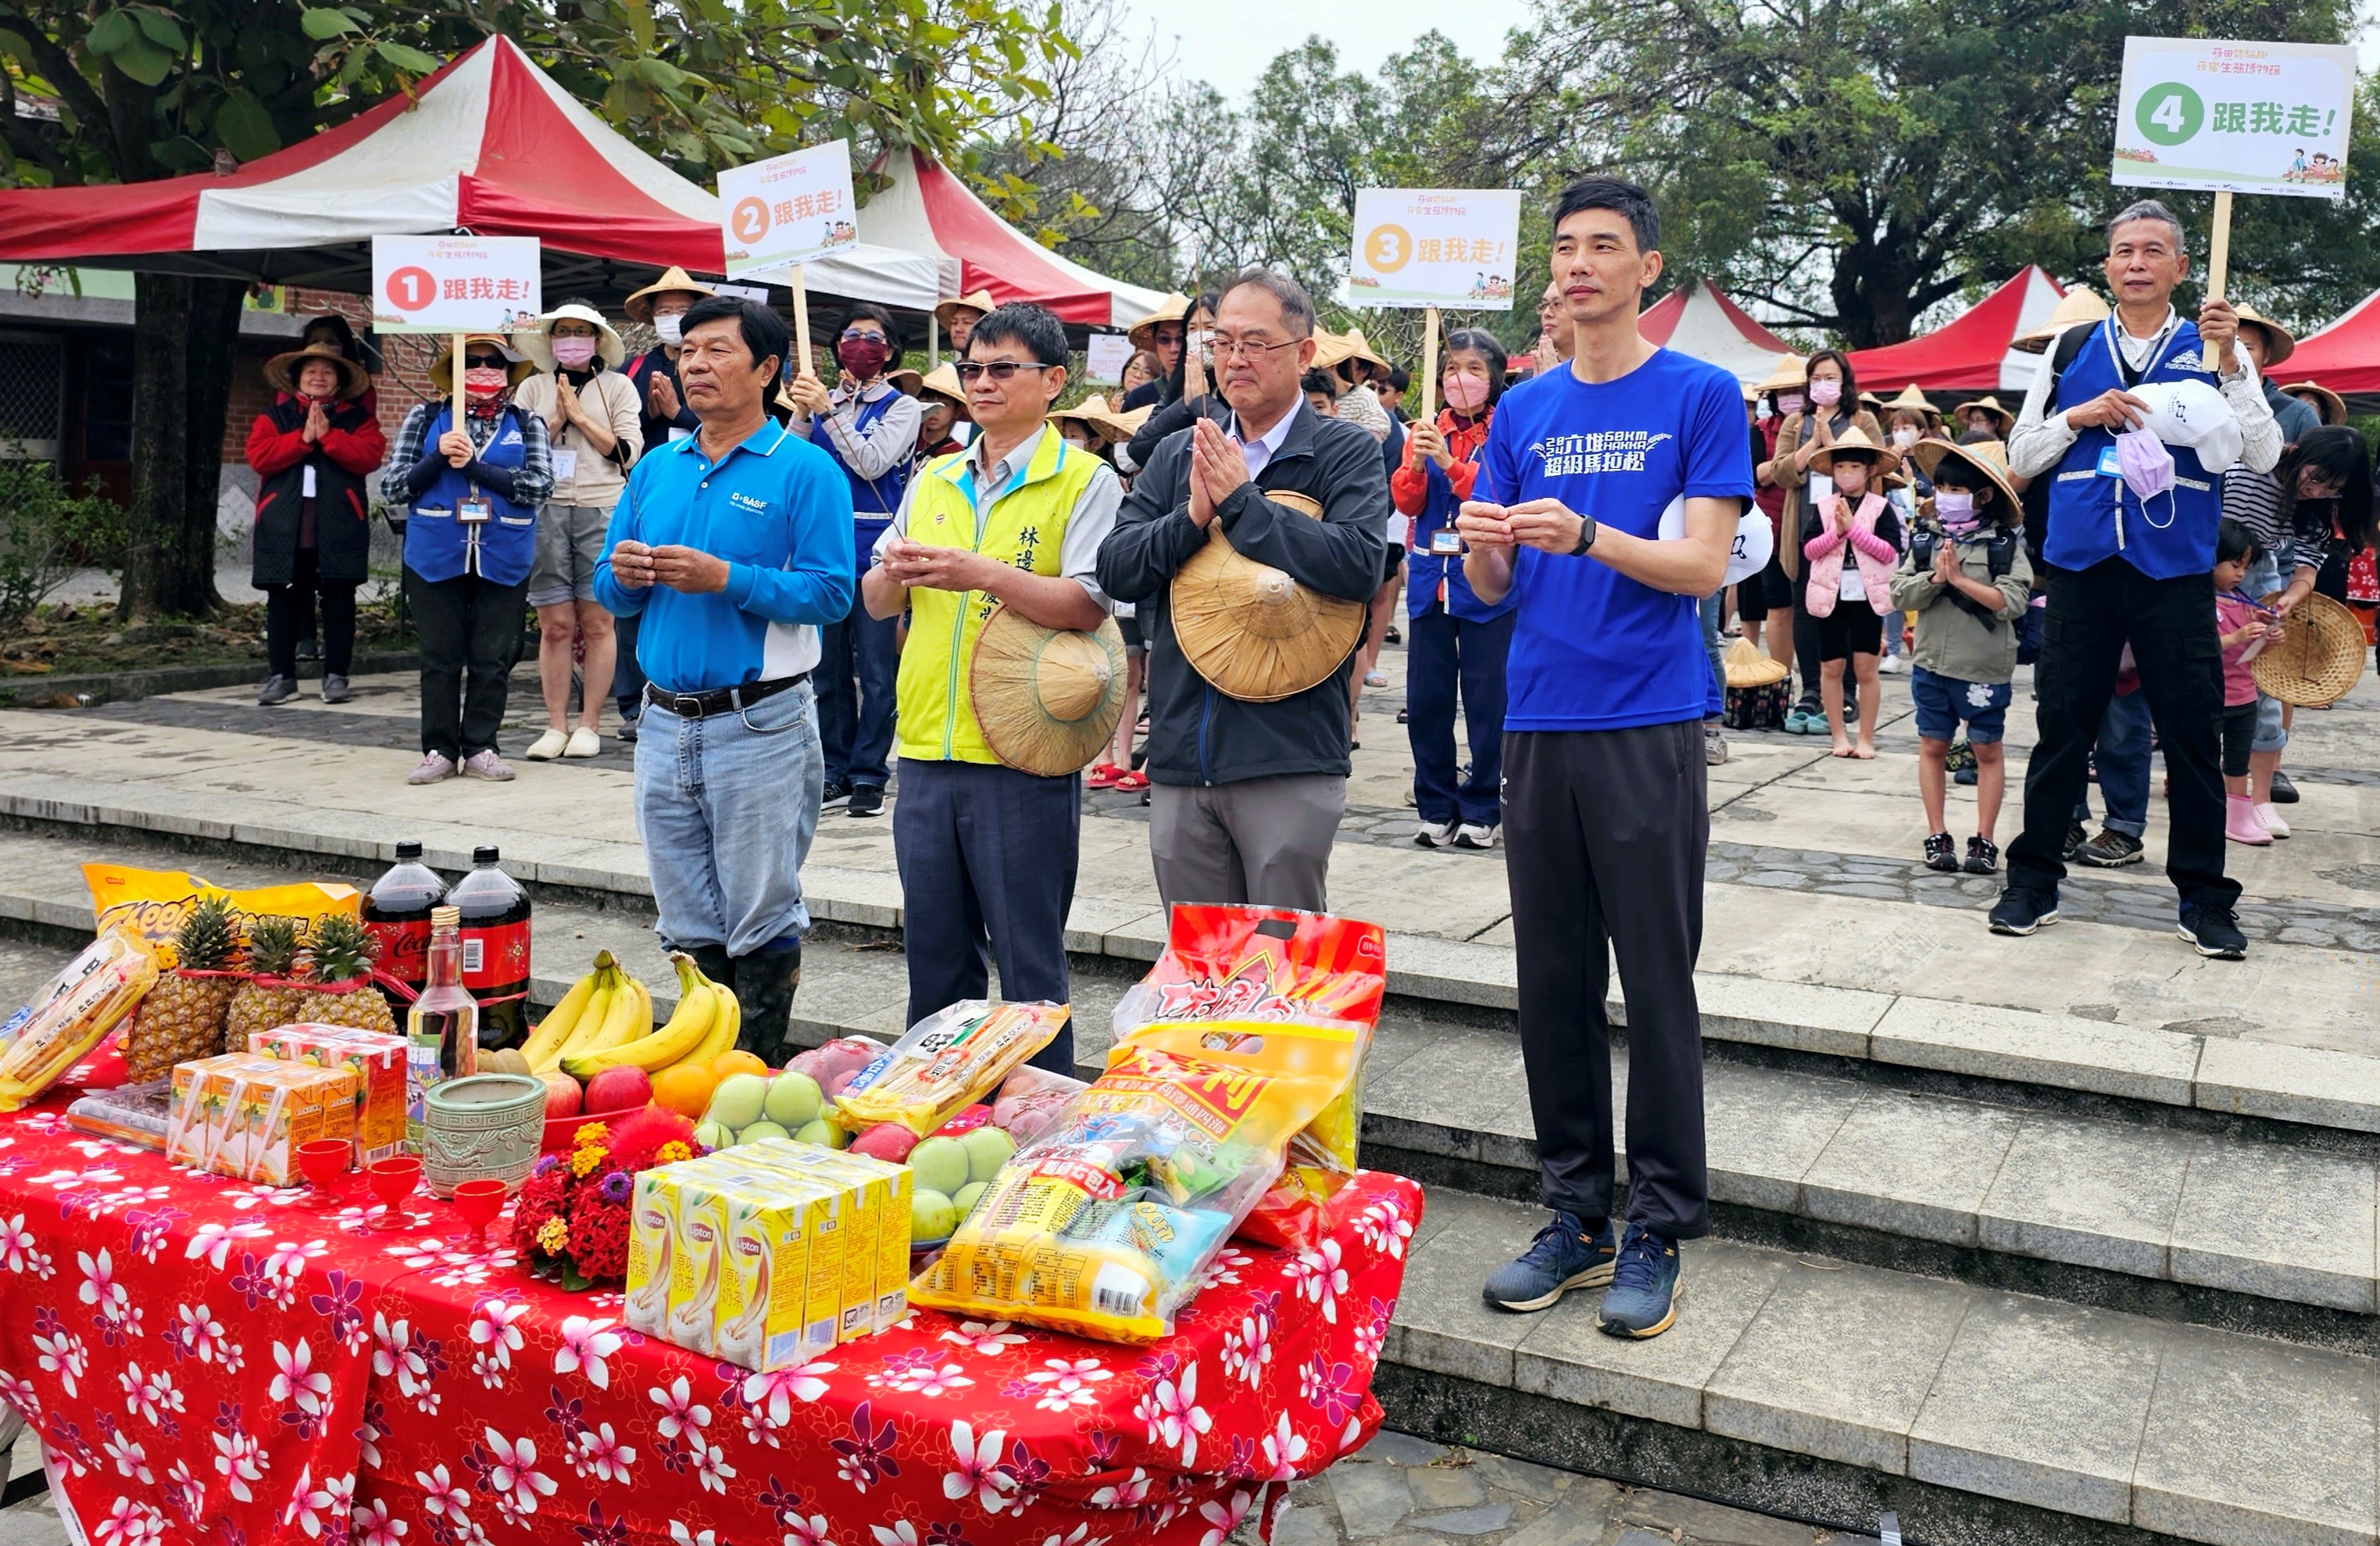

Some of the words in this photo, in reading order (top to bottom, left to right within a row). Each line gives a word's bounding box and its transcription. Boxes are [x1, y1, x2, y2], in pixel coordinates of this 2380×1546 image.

[2150, 95, 2185, 133] 4
[2212, 102, 2336, 138] 跟我走!
[774, 188, 842, 226] 跟我走!
[742, 206, 761, 235] 2
[1376, 232, 1399, 264] 3
[1417, 238, 1505, 264] 跟我走!
[402, 275, 417, 302] 1
[443, 277, 530, 300] 跟我走!
[1564, 433, 1604, 454] 六堆
[1603, 442, 1646, 451] HAKKA
[1604, 431, 1647, 442] 60KM
[1544, 451, 1646, 478] 超級馬拉松
[742, 496, 767, 509] BASF
[1160, 1111, 1217, 1154] PACK
[643, 1211, 664, 1227] Lipton
[689, 1225, 712, 1241] Lipton
[736, 1238, 759, 1254] Lipton
[630, 1260, 649, 1280] 奶茶
[674, 1274, 695, 1294] 奶茶
[721, 1288, 743, 1309] 奶茶
